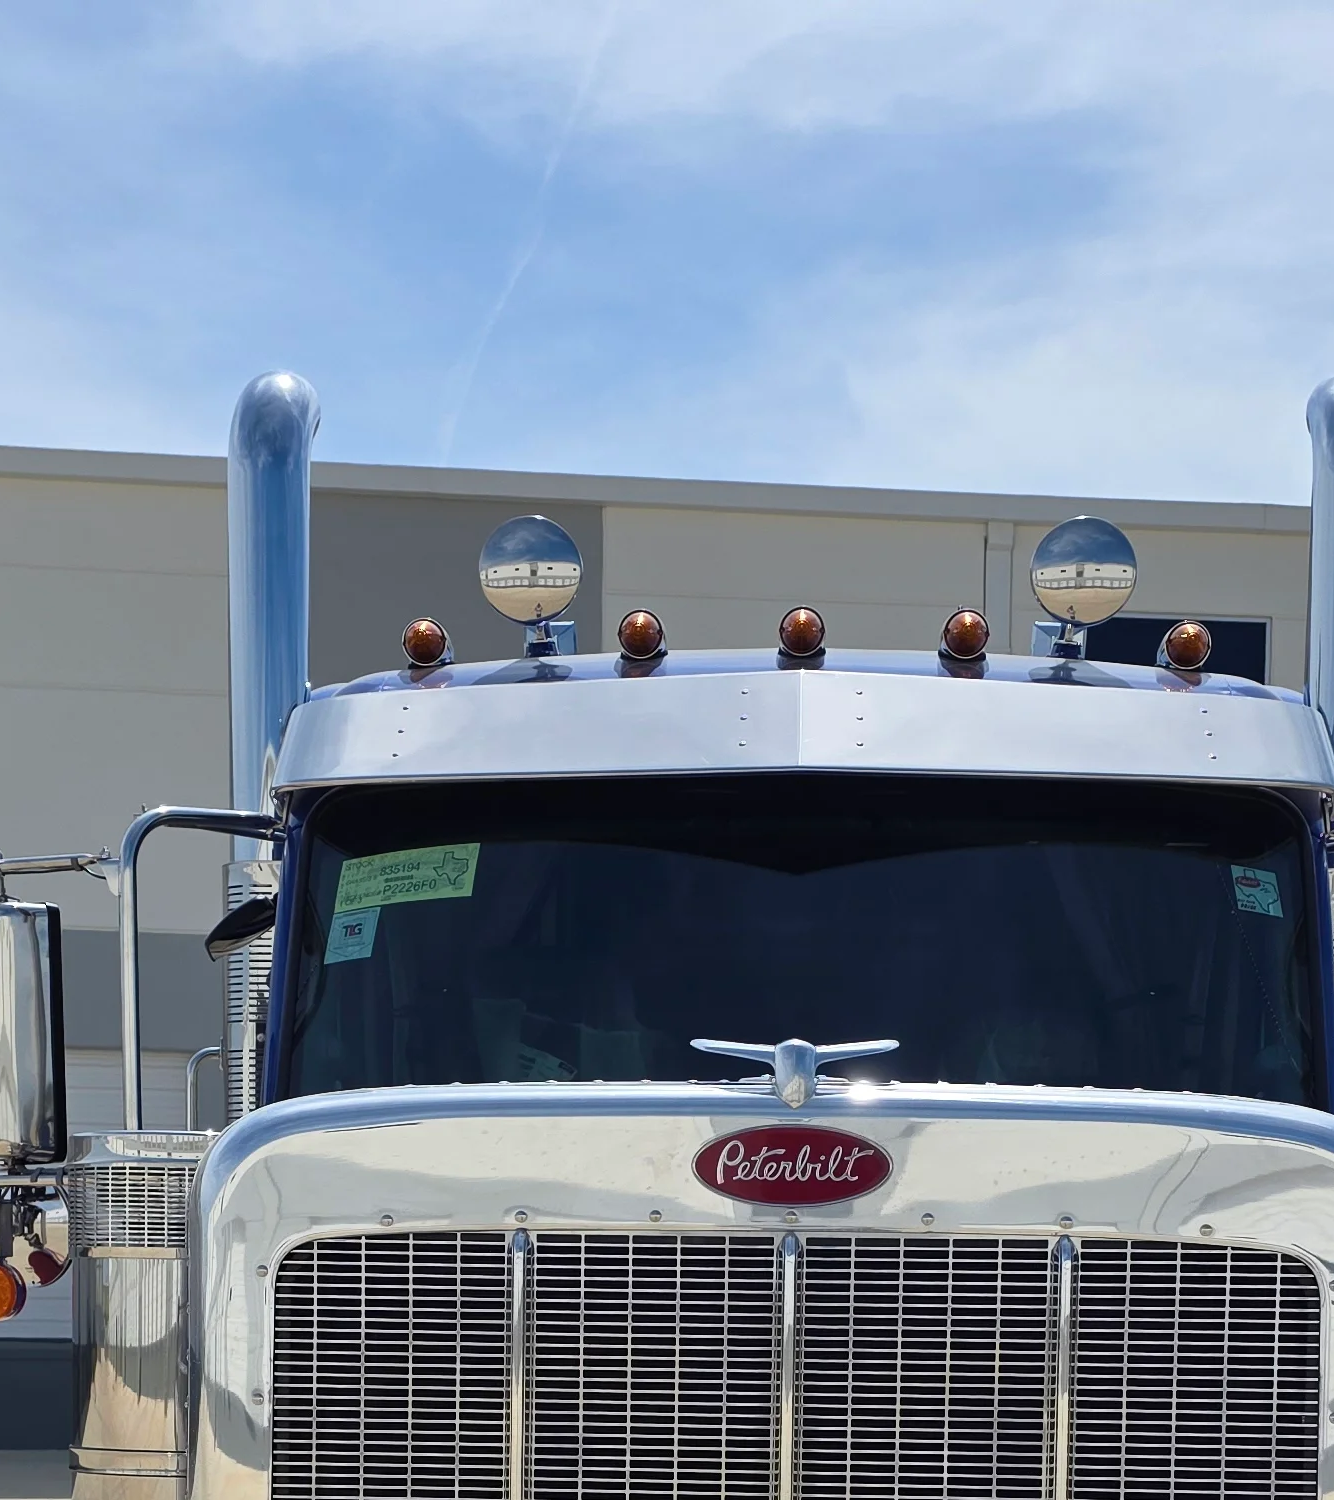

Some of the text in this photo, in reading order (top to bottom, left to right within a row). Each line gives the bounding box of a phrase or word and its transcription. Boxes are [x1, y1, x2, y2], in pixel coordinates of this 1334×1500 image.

[379, 862, 420, 876] 835194
[383, 879, 436, 895] P2226F0
[343, 923, 362, 937] TLG
[716, 1139, 875, 1185] Peterbilt
